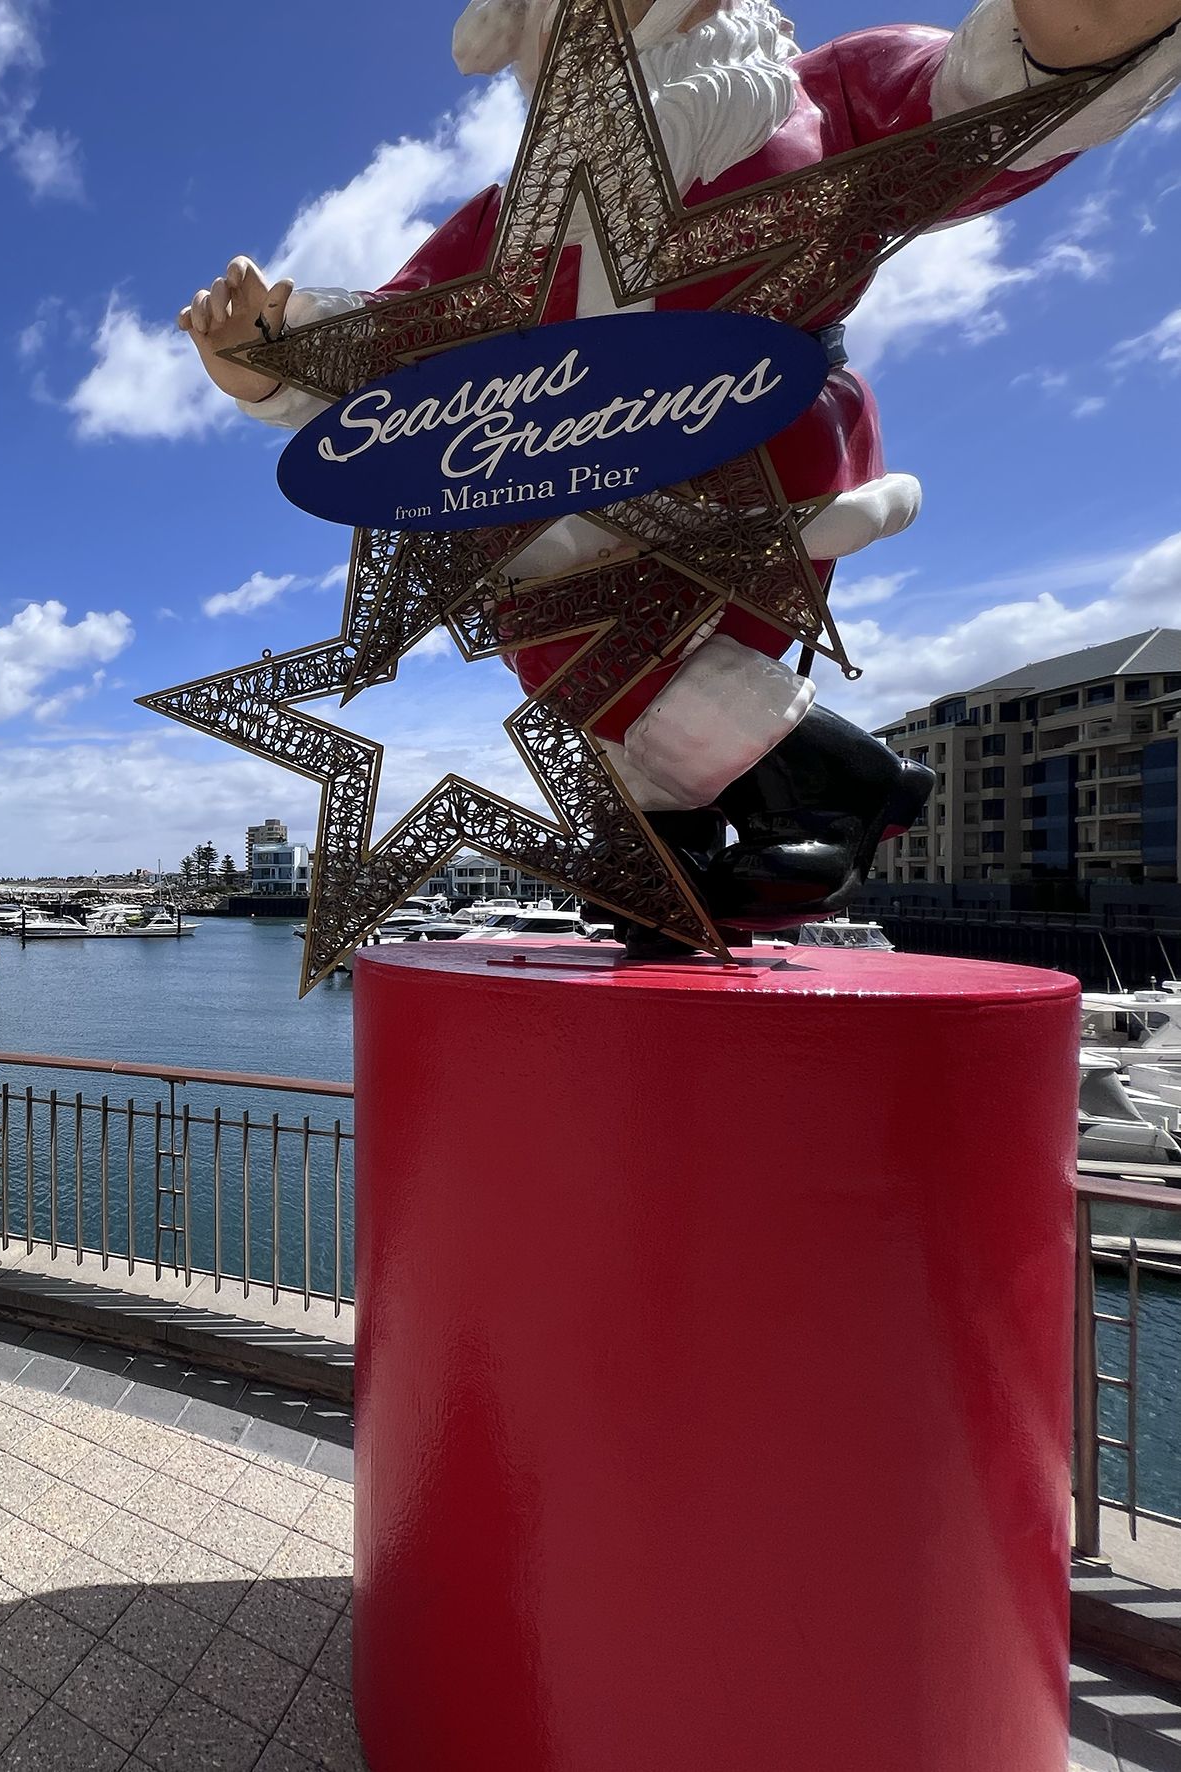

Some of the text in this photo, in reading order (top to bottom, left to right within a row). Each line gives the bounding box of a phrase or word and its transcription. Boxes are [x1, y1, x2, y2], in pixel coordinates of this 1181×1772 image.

[318, 348, 590, 462] Seasons
[441, 357, 782, 480] Greetings
[394, 464, 640, 521] from Marina Pier
